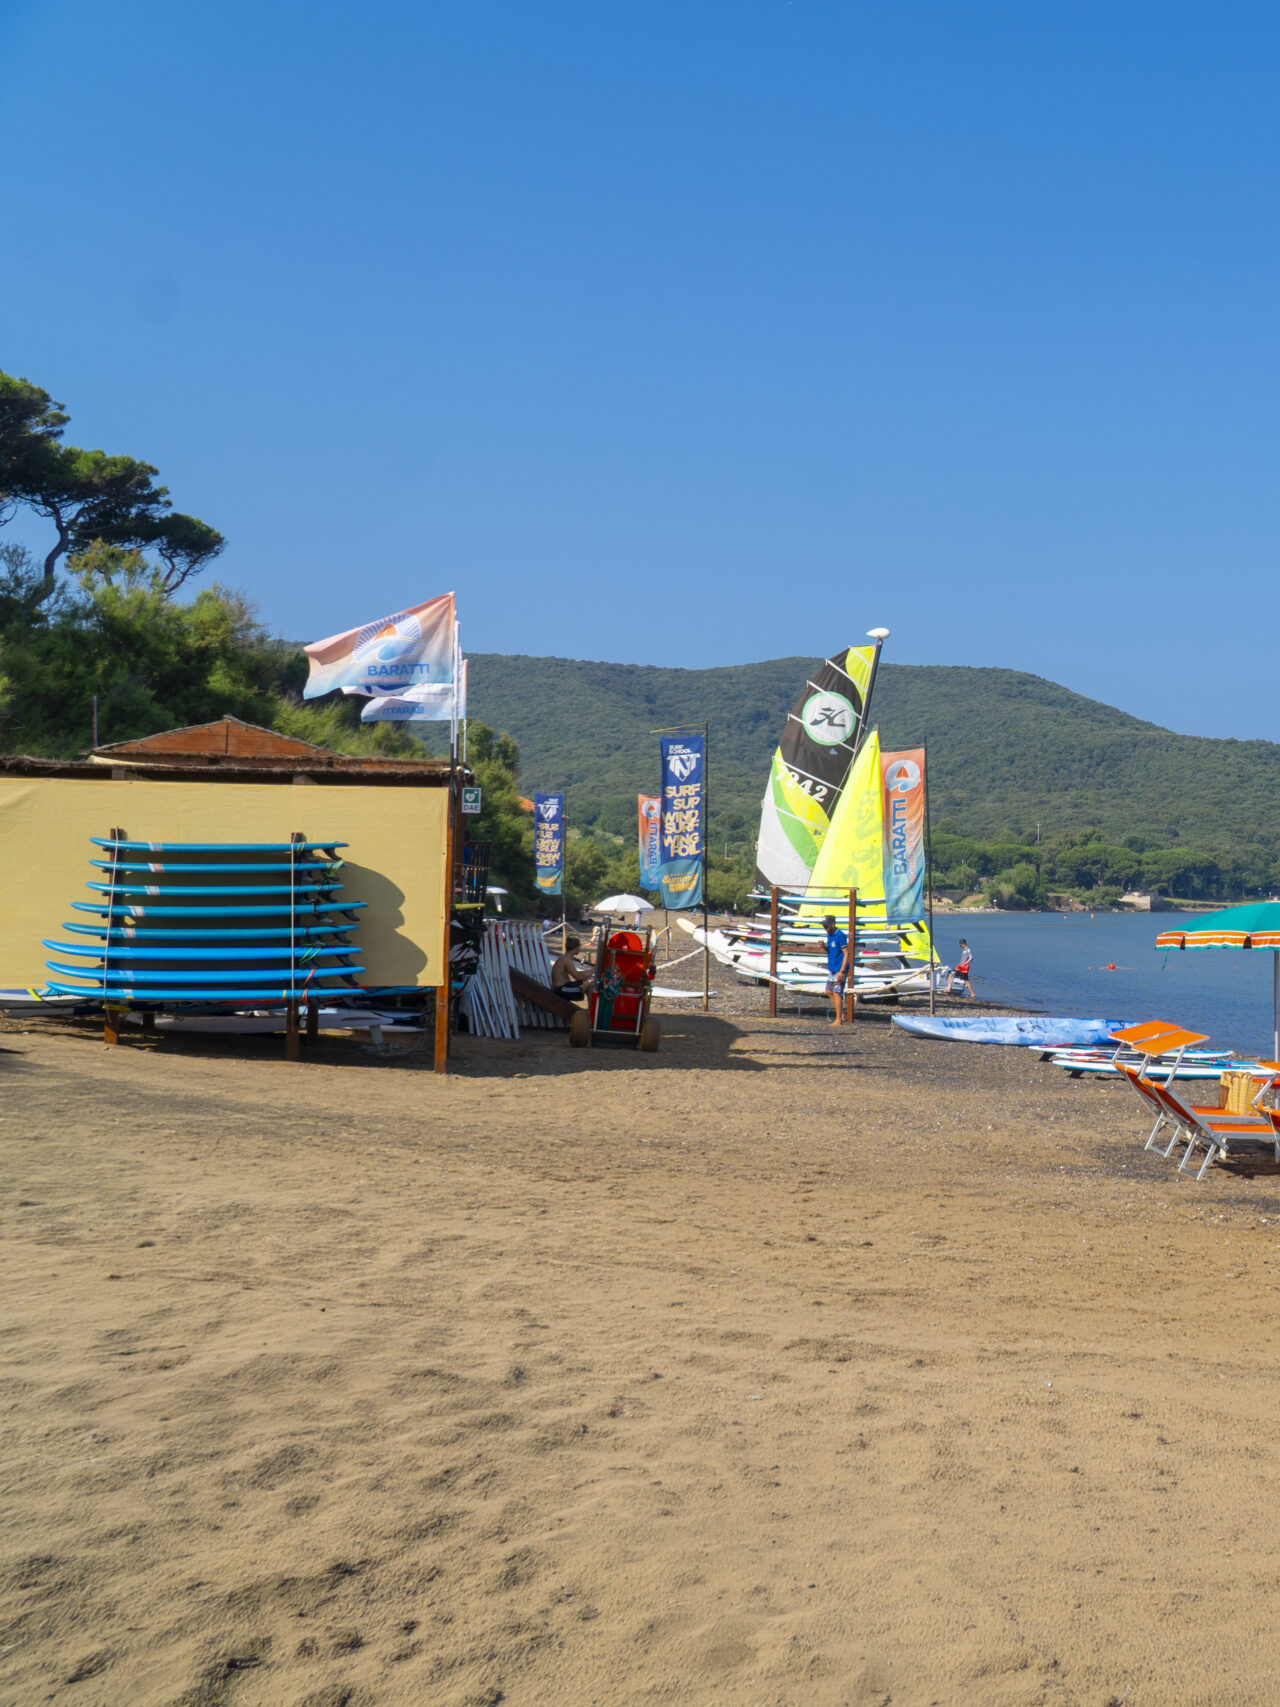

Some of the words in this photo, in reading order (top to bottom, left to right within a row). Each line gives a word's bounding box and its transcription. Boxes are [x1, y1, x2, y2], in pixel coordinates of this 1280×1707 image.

[367, 663, 430, 676] BARATTI
[665, 784, 701, 798] SURF
[775, 764, 829, 803] 7242
[673, 797, 701, 810] SUP
[661, 810, 699, 824] WIND
[664, 819, 700, 834] SURF
[662, 832, 700, 848] WING
[892, 798, 908, 876] BARATTI
[670, 842, 701, 858] FOIL
